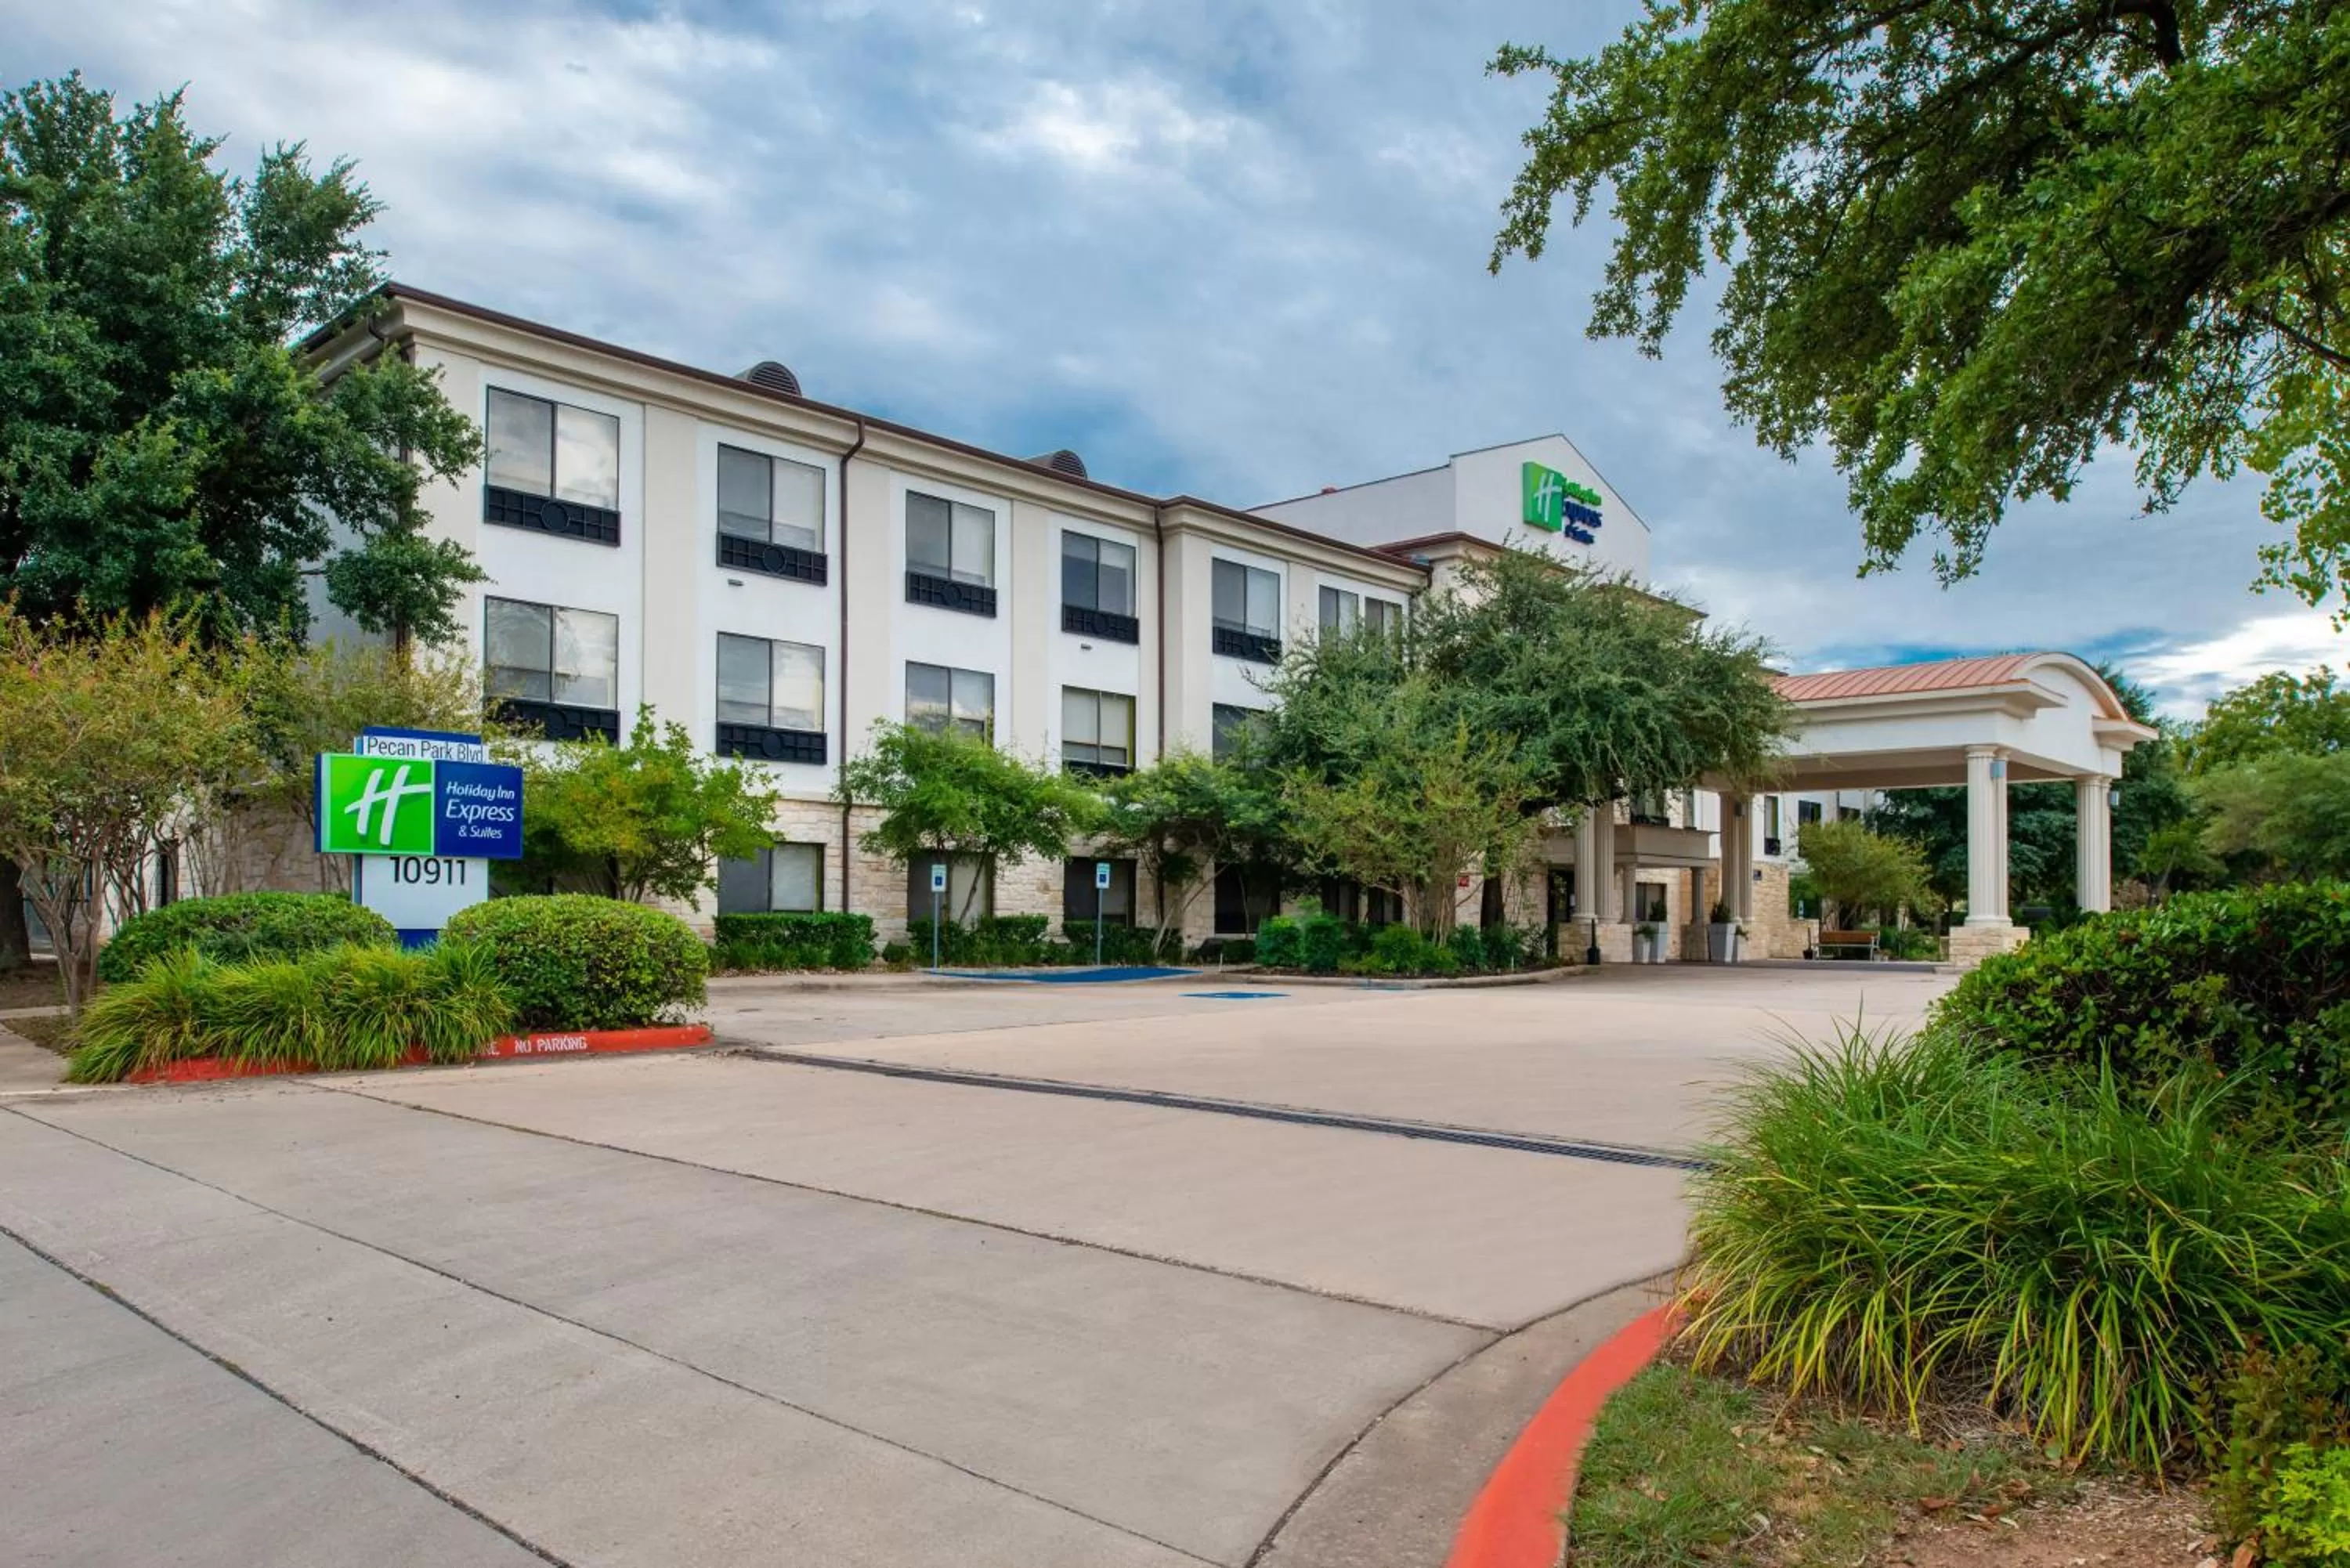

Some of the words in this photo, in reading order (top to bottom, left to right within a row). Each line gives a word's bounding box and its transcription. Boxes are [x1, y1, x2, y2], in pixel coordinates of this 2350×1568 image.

[367, 737, 416, 757] Pecan
[421, 740, 452, 760] Park
[457, 743, 483, 762] Blvd
[446, 781, 496, 801] Holiday
[497, 784, 515, 800] Inn
[446, 798, 515, 825] Express
[458, 825, 468, 837] &
[469, 825, 502, 840] Suites
[389, 856, 465, 886] 10911
[514, 1039, 532, 1053] NO
[537, 1035, 588, 1052] PARKING
